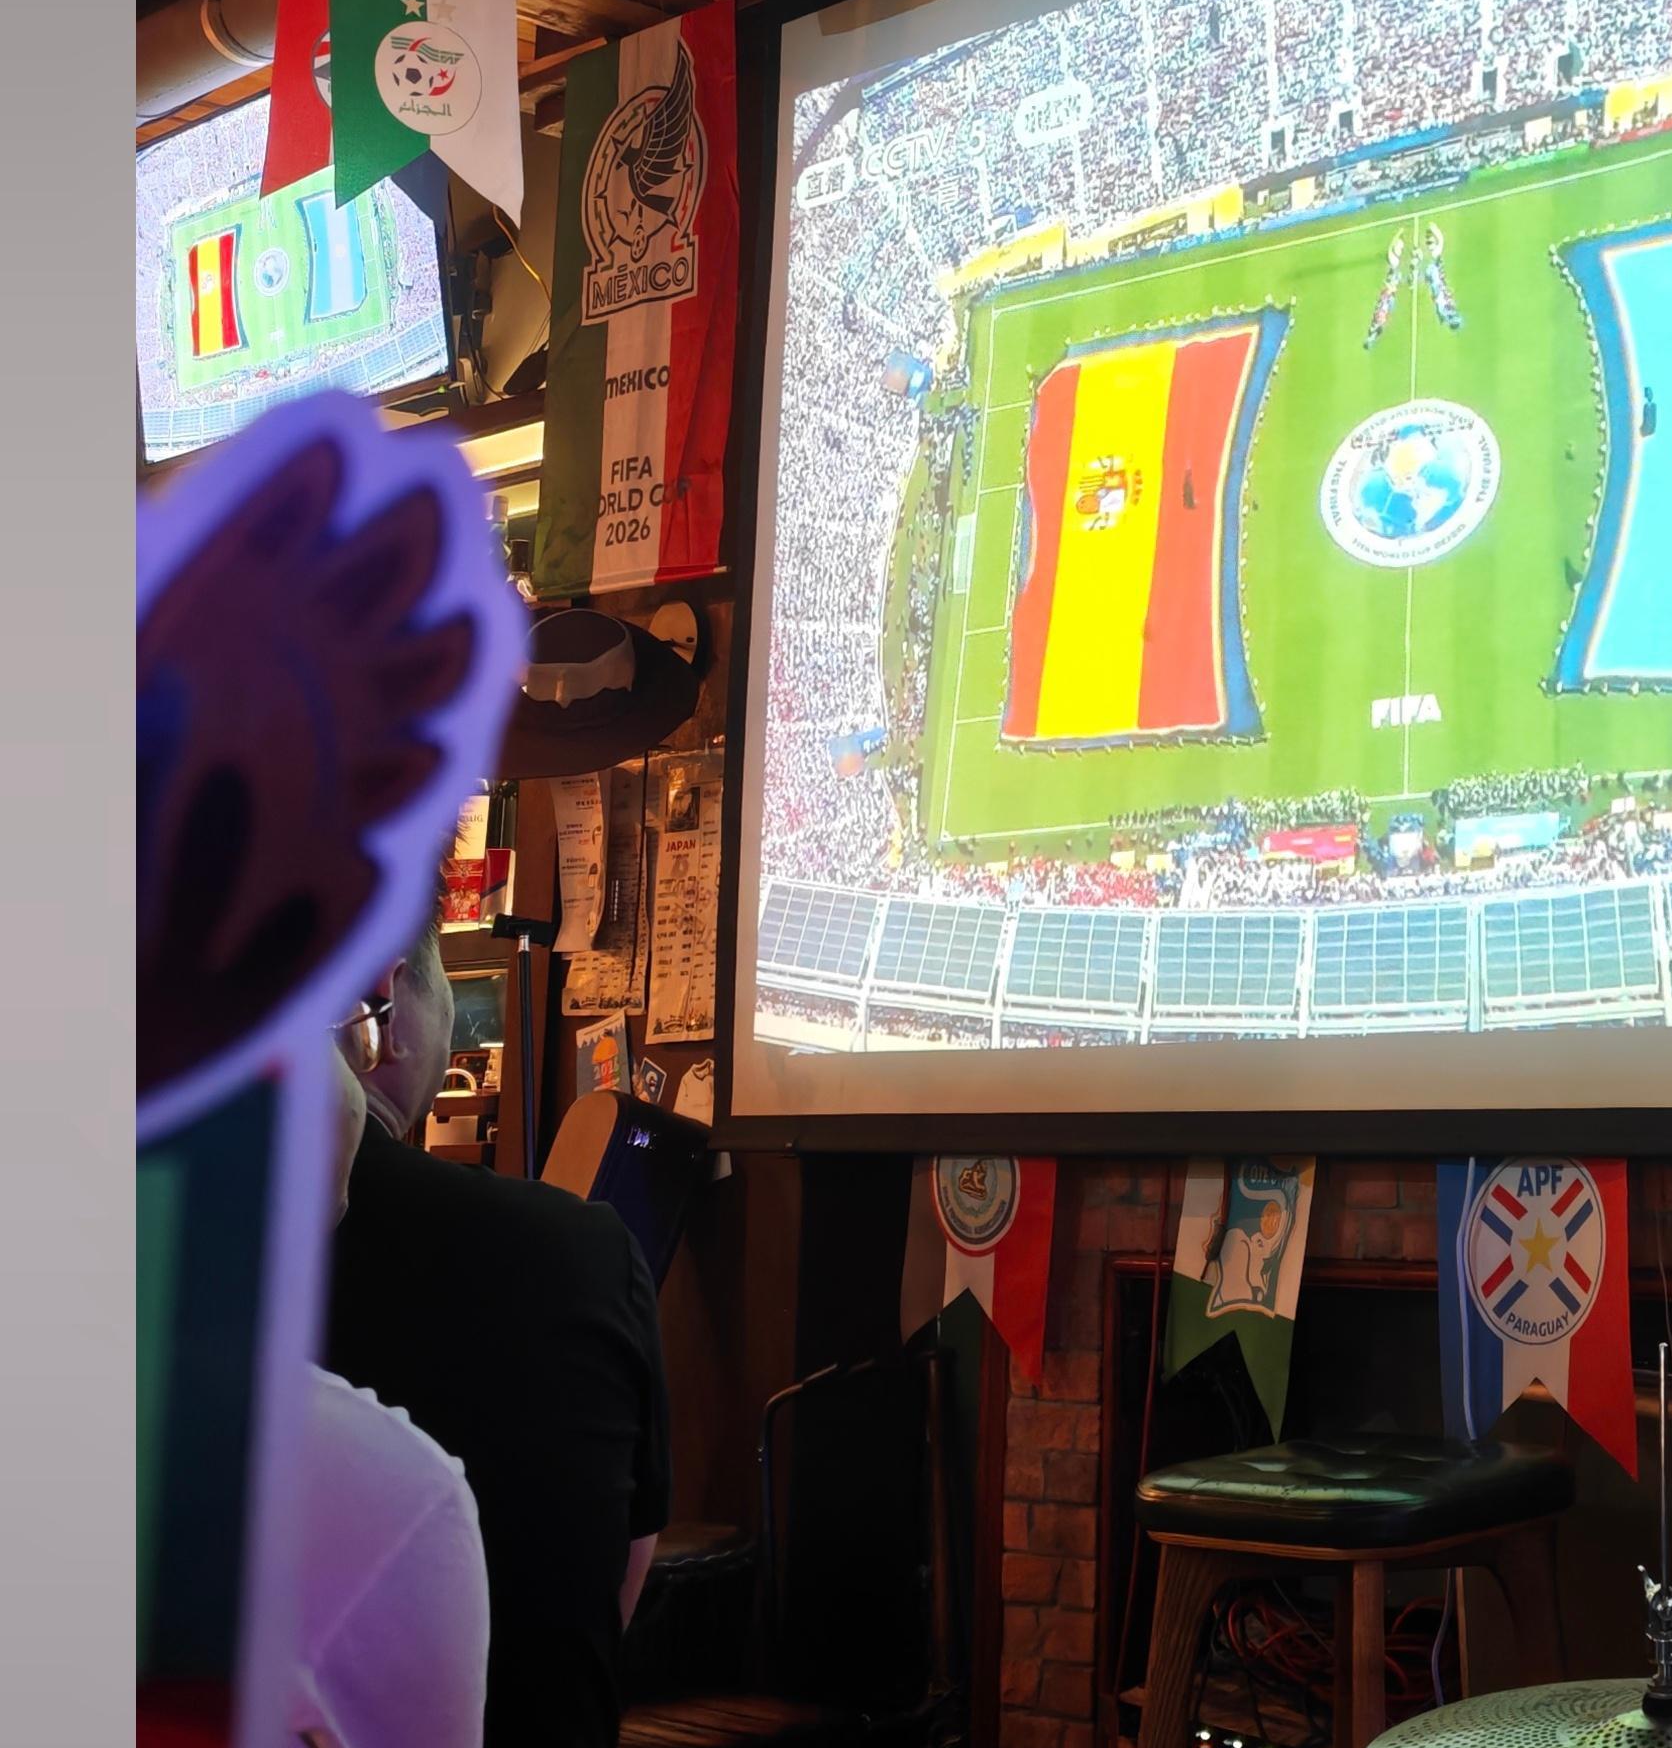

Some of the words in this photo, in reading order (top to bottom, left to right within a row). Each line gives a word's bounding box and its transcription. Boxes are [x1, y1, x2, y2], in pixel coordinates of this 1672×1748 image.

[610, 455, 654, 486] FIFA
[598, 487, 644, 520] ORLD
[605, 516, 651, 548] 2026
[1370, 693, 1442, 730] FIFA
[665, 838, 697, 854] JAPAN
[1516, 1163, 1565, 1198] APF
[1504, 1311, 1571, 1338] PARAGUAY
